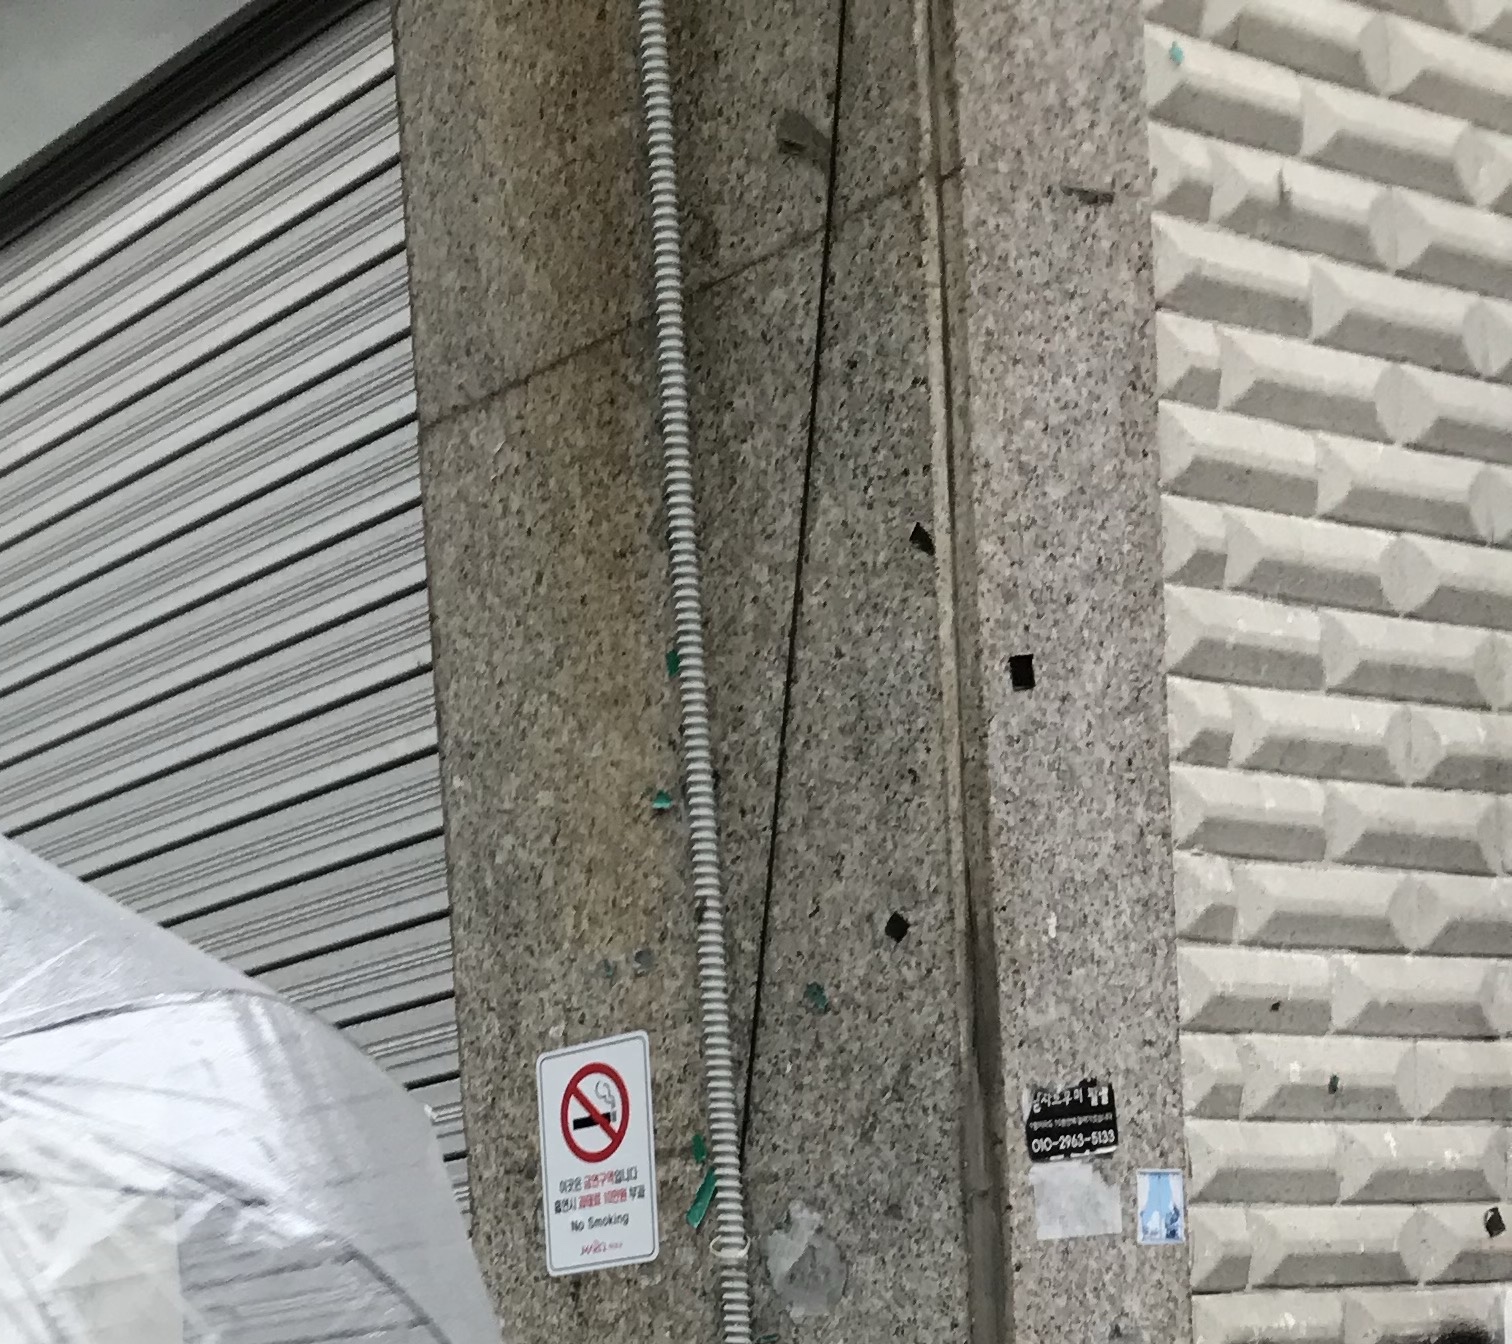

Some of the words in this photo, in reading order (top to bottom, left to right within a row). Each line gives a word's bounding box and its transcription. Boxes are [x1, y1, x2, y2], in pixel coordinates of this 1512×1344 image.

[1031, 1129, 1115, 1153] 010-2963-5133
[571, 1220, 585, 1232] No
[587, 1213, 629, 1229] Smoking
